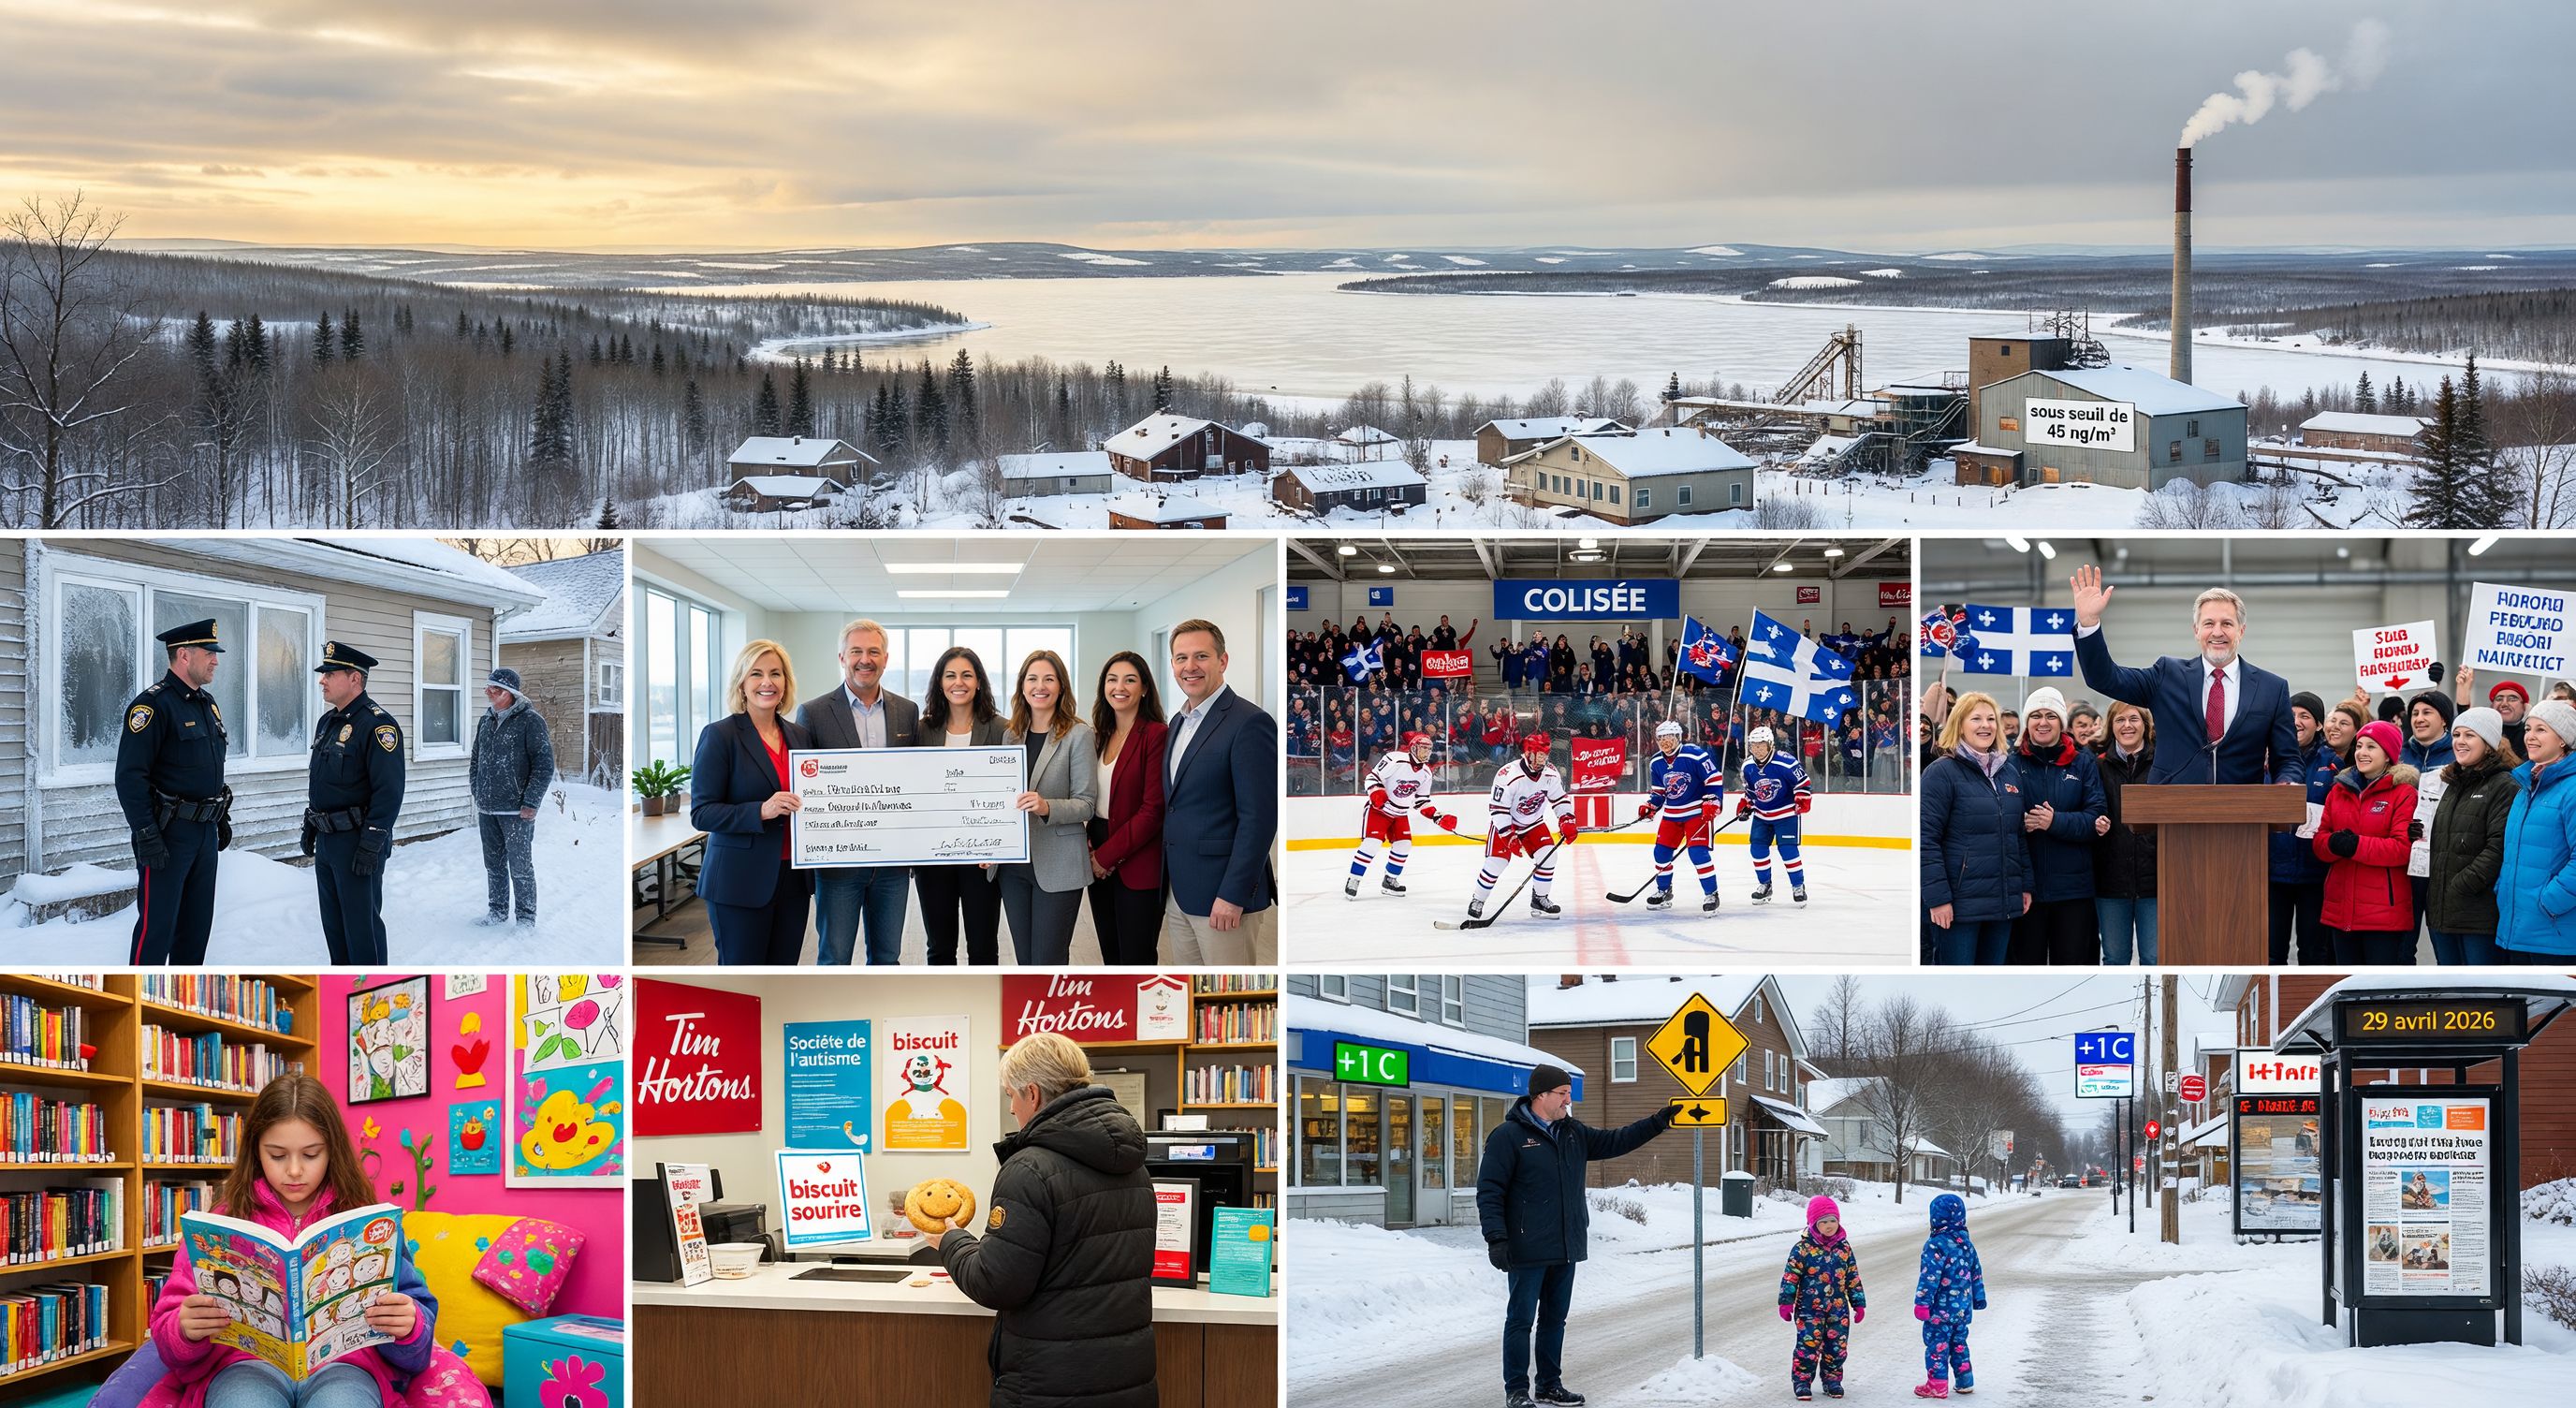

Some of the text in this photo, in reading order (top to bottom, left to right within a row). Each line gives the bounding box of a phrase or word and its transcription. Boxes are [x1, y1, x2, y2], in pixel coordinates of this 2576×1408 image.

[2030, 407, 2129, 423] sous seuil de
[2047, 424, 2066, 438] 45
[1524, 581, 1646, 611] COLISÉE
[2363, 1010, 2496, 1031] 29 avril 2026
[666, 1012, 721, 1057] Tim
[789, 1034, 867, 1050] Société de
[893, 1031, 959, 1051] biscuit
[2078, 1037, 2130, 1059] +1 C
[790, 1051, 861, 1067] l'autisme
[1338, 1049, 1396, 1080] +1 C
[789, 1178, 858, 1199] biscuit
[791, 1201, 862, 1221] sourire
